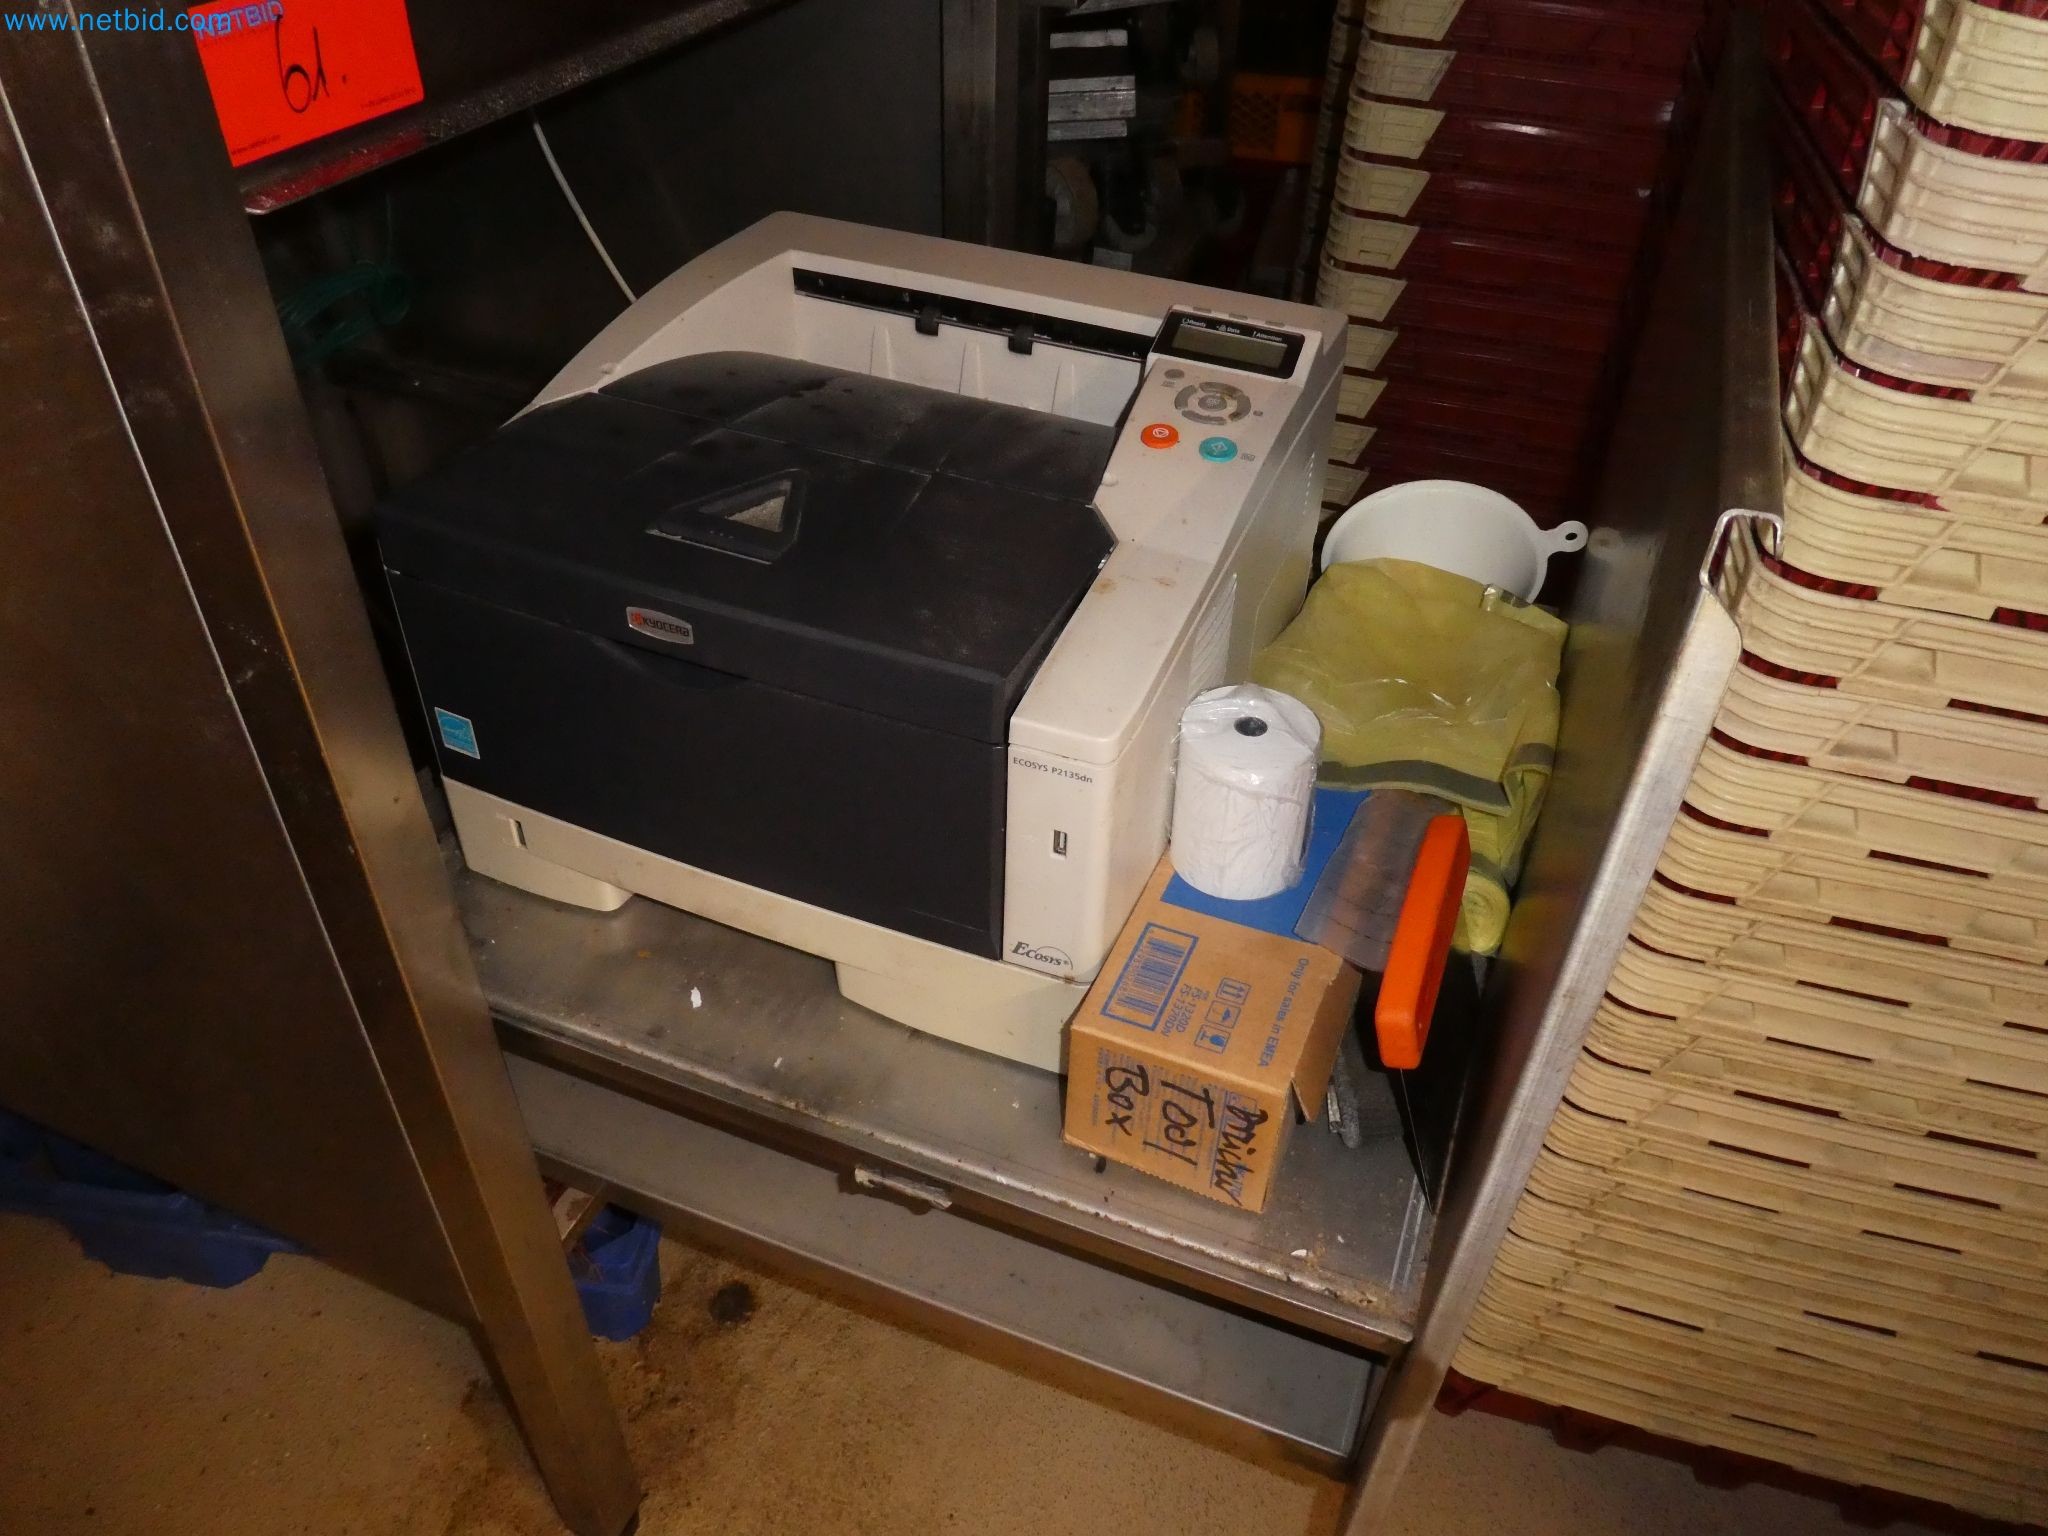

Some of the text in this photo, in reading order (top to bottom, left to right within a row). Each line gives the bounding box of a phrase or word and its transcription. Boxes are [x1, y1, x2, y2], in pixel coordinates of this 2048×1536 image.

[198, 0, 284, 40] NETBID
[643, 617, 689, 637] KYOCERA
[1013, 757, 1093, 783] ECOSYS P2135dn
[1162, 983, 1189, 1038] FS-1370DN
[1176, 987, 1203, 1033] FS-1320D
[1257, 957, 1309, 1068] Only for sales in EMEA
[1104, 1064, 1150, 1137] Box
[1143, 1079, 1214, 1167] Tool
